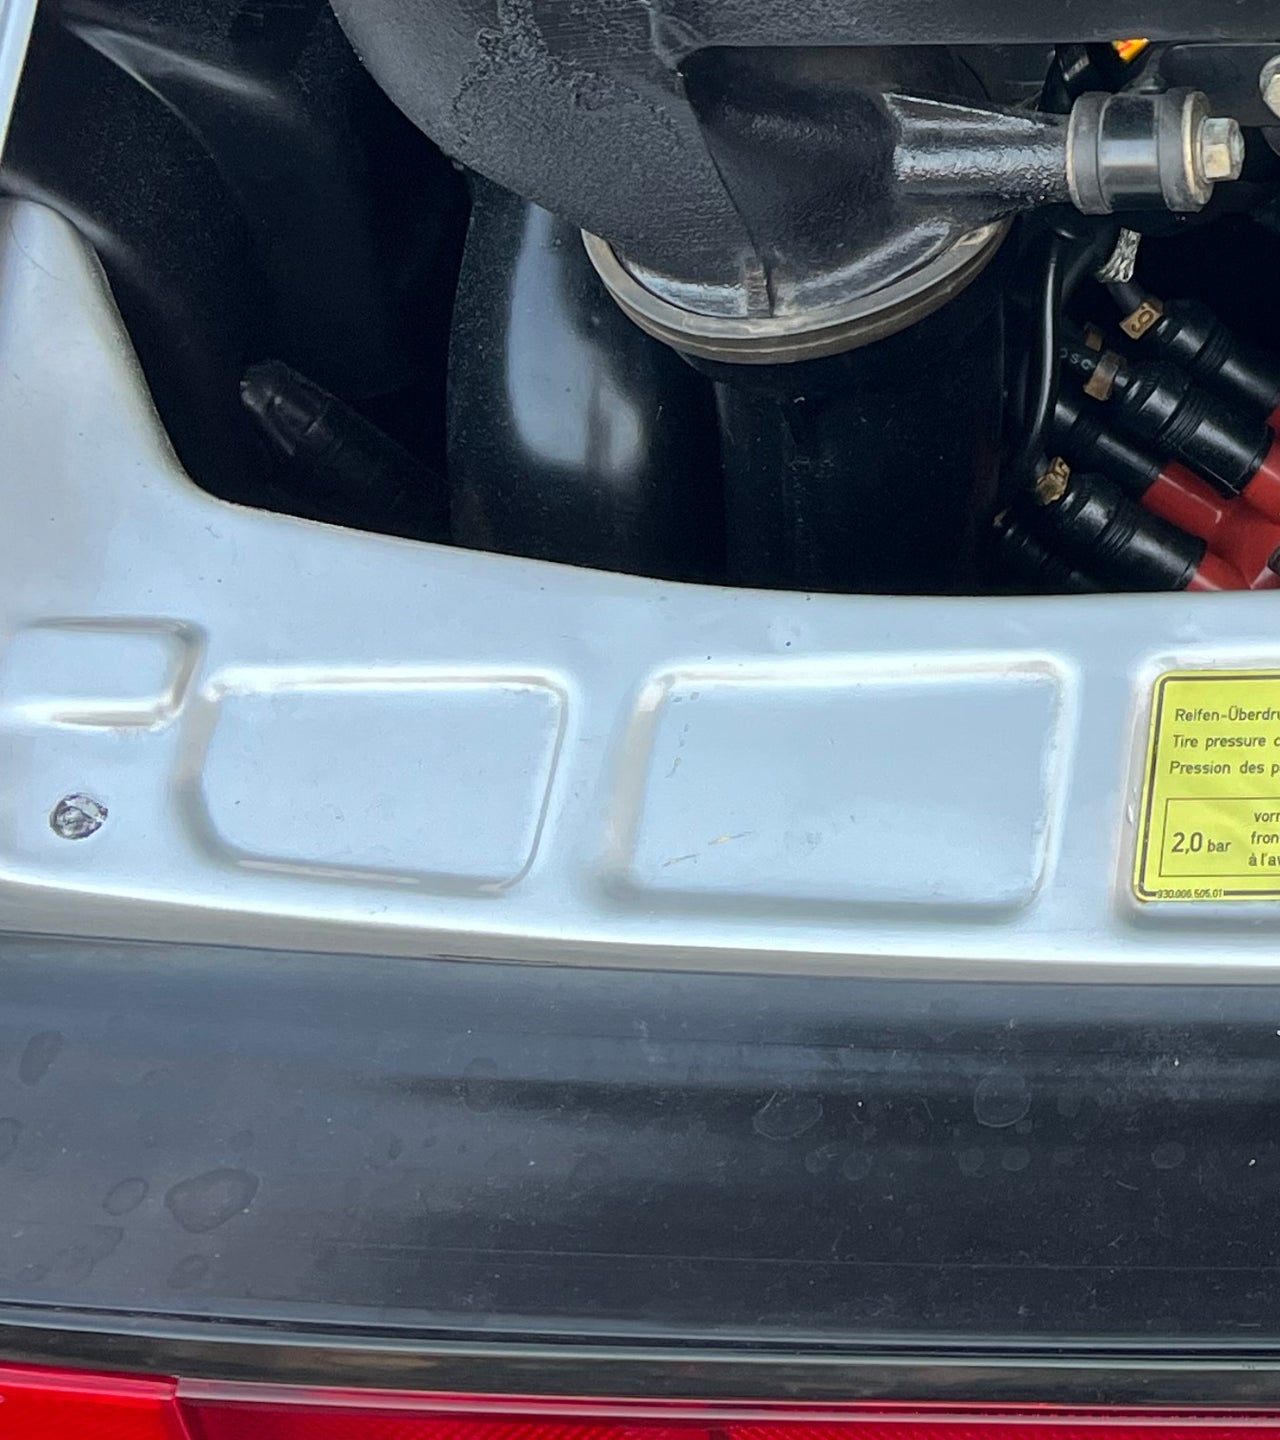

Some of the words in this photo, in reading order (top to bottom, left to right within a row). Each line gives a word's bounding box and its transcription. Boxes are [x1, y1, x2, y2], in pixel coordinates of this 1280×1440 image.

[1173, 734, 1198, 748] Tire
[1205, 735, 1266, 751] pressure
[1169, 761, 1231, 774] Pression
[1239, 760, 1265, 774] des
[1171, 832, 1203, 855] 2,0
[1207, 839, 1232, 853] bar
[1248, 853, 1258, 866] à
